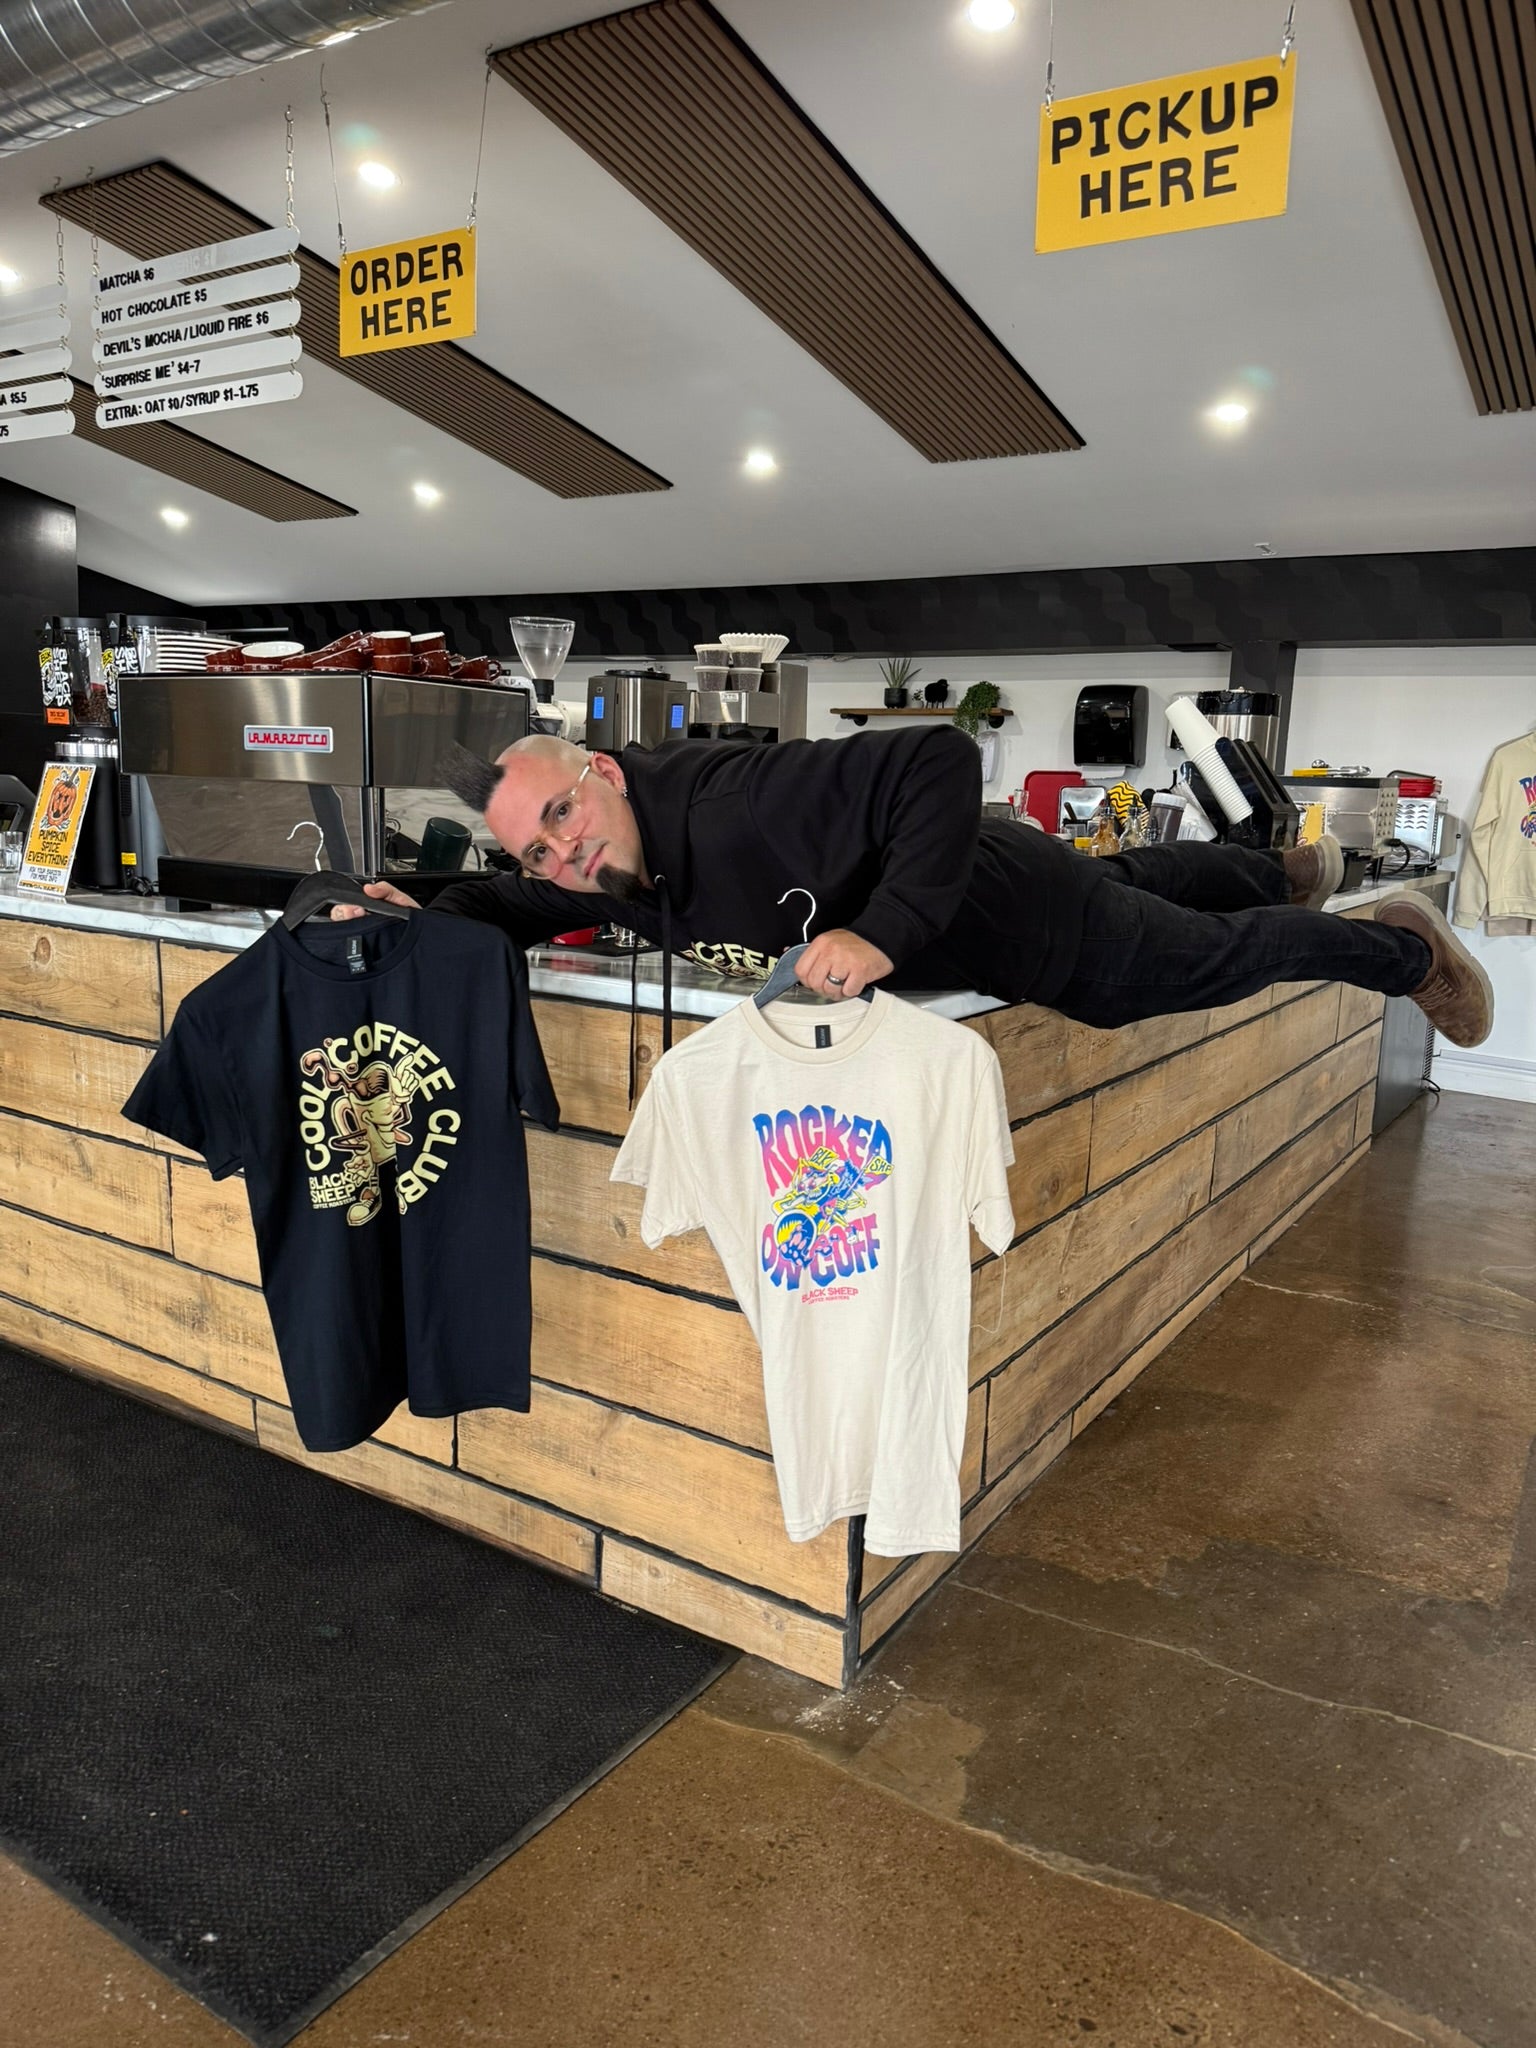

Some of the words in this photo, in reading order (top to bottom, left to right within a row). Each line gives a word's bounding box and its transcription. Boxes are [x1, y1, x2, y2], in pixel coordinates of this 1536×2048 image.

[1052, 75, 1279, 165] PICKUP
[1080, 144, 1239, 219] HERE
[100, 271, 141, 292] MATCHA
[143, 267, 155, 281] $6
[350, 242, 463, 296] ORDER
[101, 307, 123, 324] HOT
[127, 291, 191, 318] CHOCOLATE
[194, 288, 208, 303] $5
[360, 288, 452, 340] HERE
[103, 337, 141, 357] DEVIL'S
[228, 313, 253, 331] FIRE
[256, 310, 269, 326] $6
[177, 359, 201, 375] $4-7
[105, 404, 142, 422] EXTRA:
[145, 398, 166, 413] OAT
[223, 383, 259, 402] $1-1.75
[59, 648, 72, 706] BLACK
[39, 829, 69, 842] PUMPKIN
[41, 841, 61, 853] SPICE
[27, 850, 69, 866] EVERYTHING
[299, 1080, 332, 1172] COOL
[327, 1021, 456, 1102] COFFEE
[397, 1109, 461, 1204] CLUB
[752, 1104, 893, 1197] ROCKED
[309, 1172, 352, 1190] BLACK
[310, 1183, 356, 1203] SHEEP
[801, 1288, 827, 1303] BLACK
[827, 1286, 859, 1296] SHEEP
